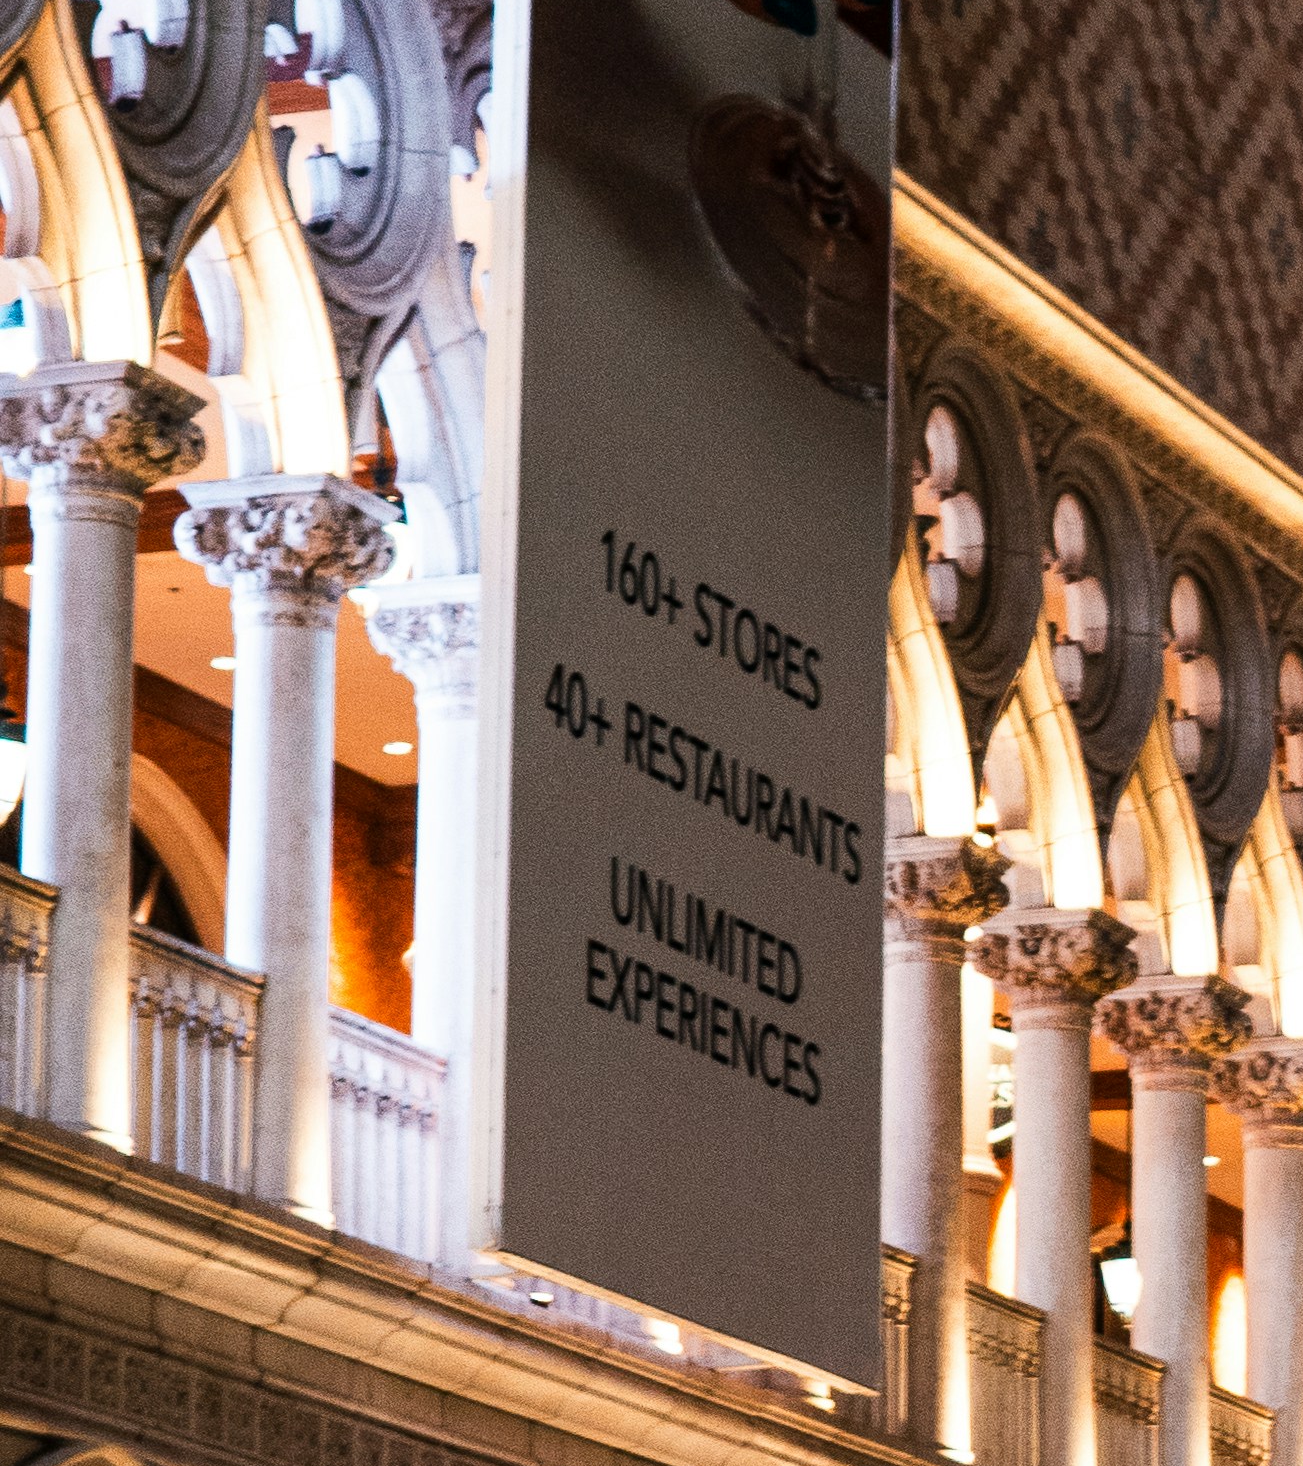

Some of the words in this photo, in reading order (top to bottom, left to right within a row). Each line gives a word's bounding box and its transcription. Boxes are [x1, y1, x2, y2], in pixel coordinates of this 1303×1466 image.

[601, 529, 684, 625] 160+
[694, 581, 822, 711] STORES
[544, 663, 612, 746] 40+
[624, 701, 863, 886] RESTAURANTS
[610, 856, 802, 1006] UNLIMITED
[585, 938, 822, 1107] EXPERIENCES
